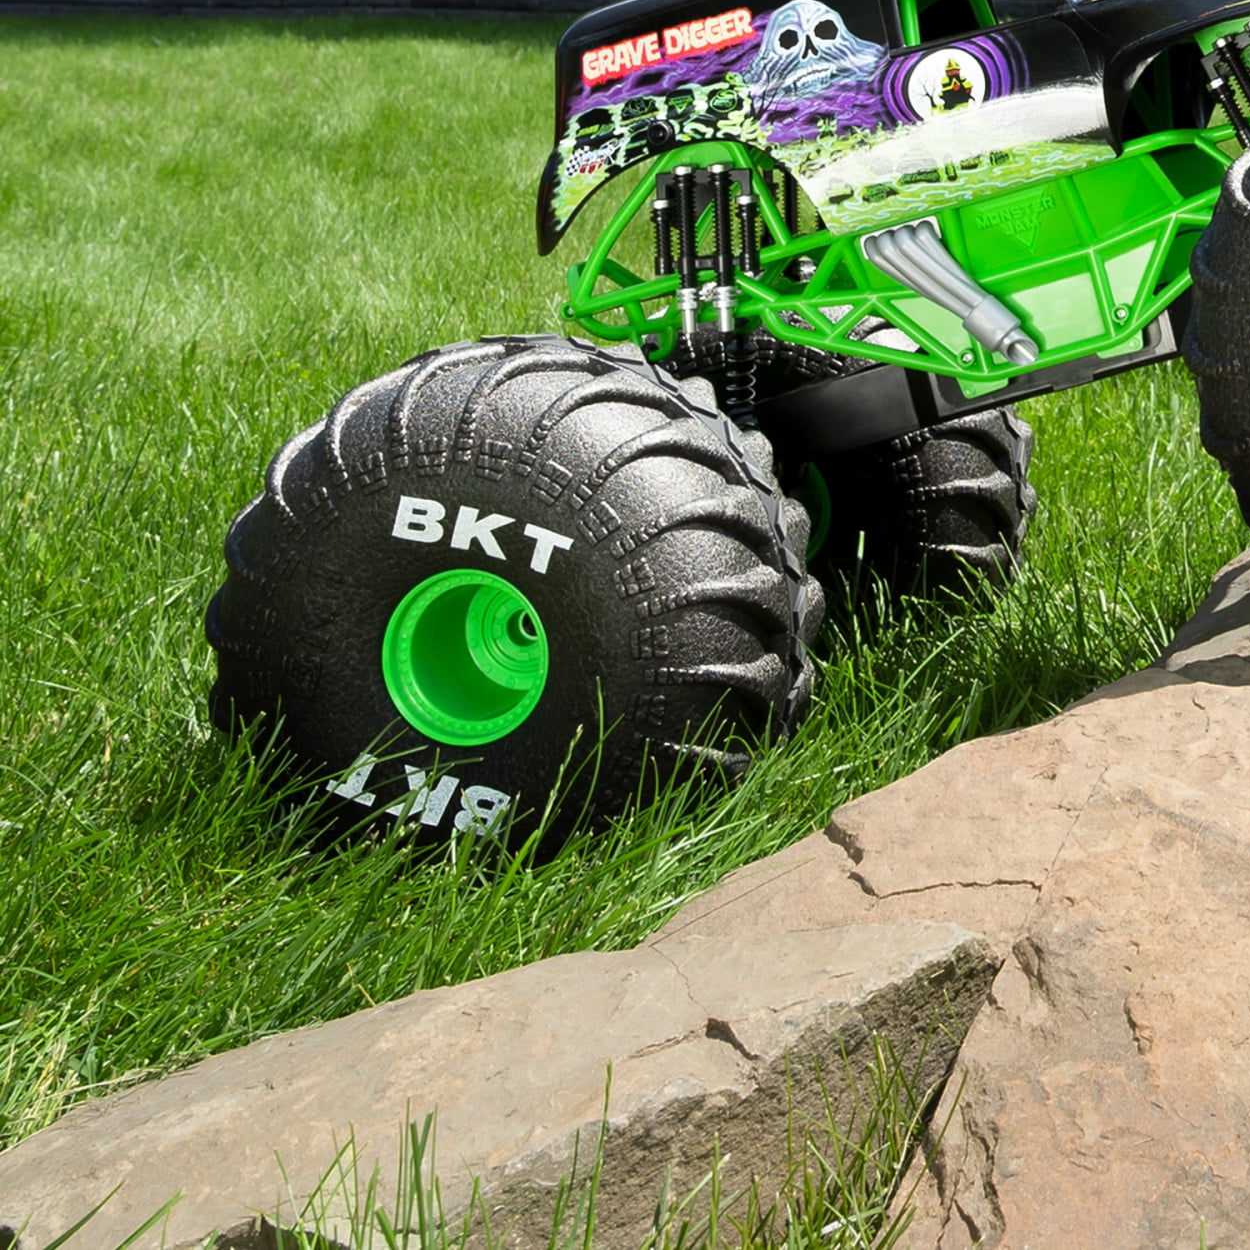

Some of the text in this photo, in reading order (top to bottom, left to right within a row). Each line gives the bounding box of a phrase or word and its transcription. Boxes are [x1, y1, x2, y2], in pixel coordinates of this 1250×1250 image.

[582, 8, 754, 82] GRAVE DIGGER
[975, 194, 1056, 230] MONSTER
[1001, 215, 1041, 236] JAM
[392, 495, 574, 574] BKT
[325, 752, 512, 836] BKT
